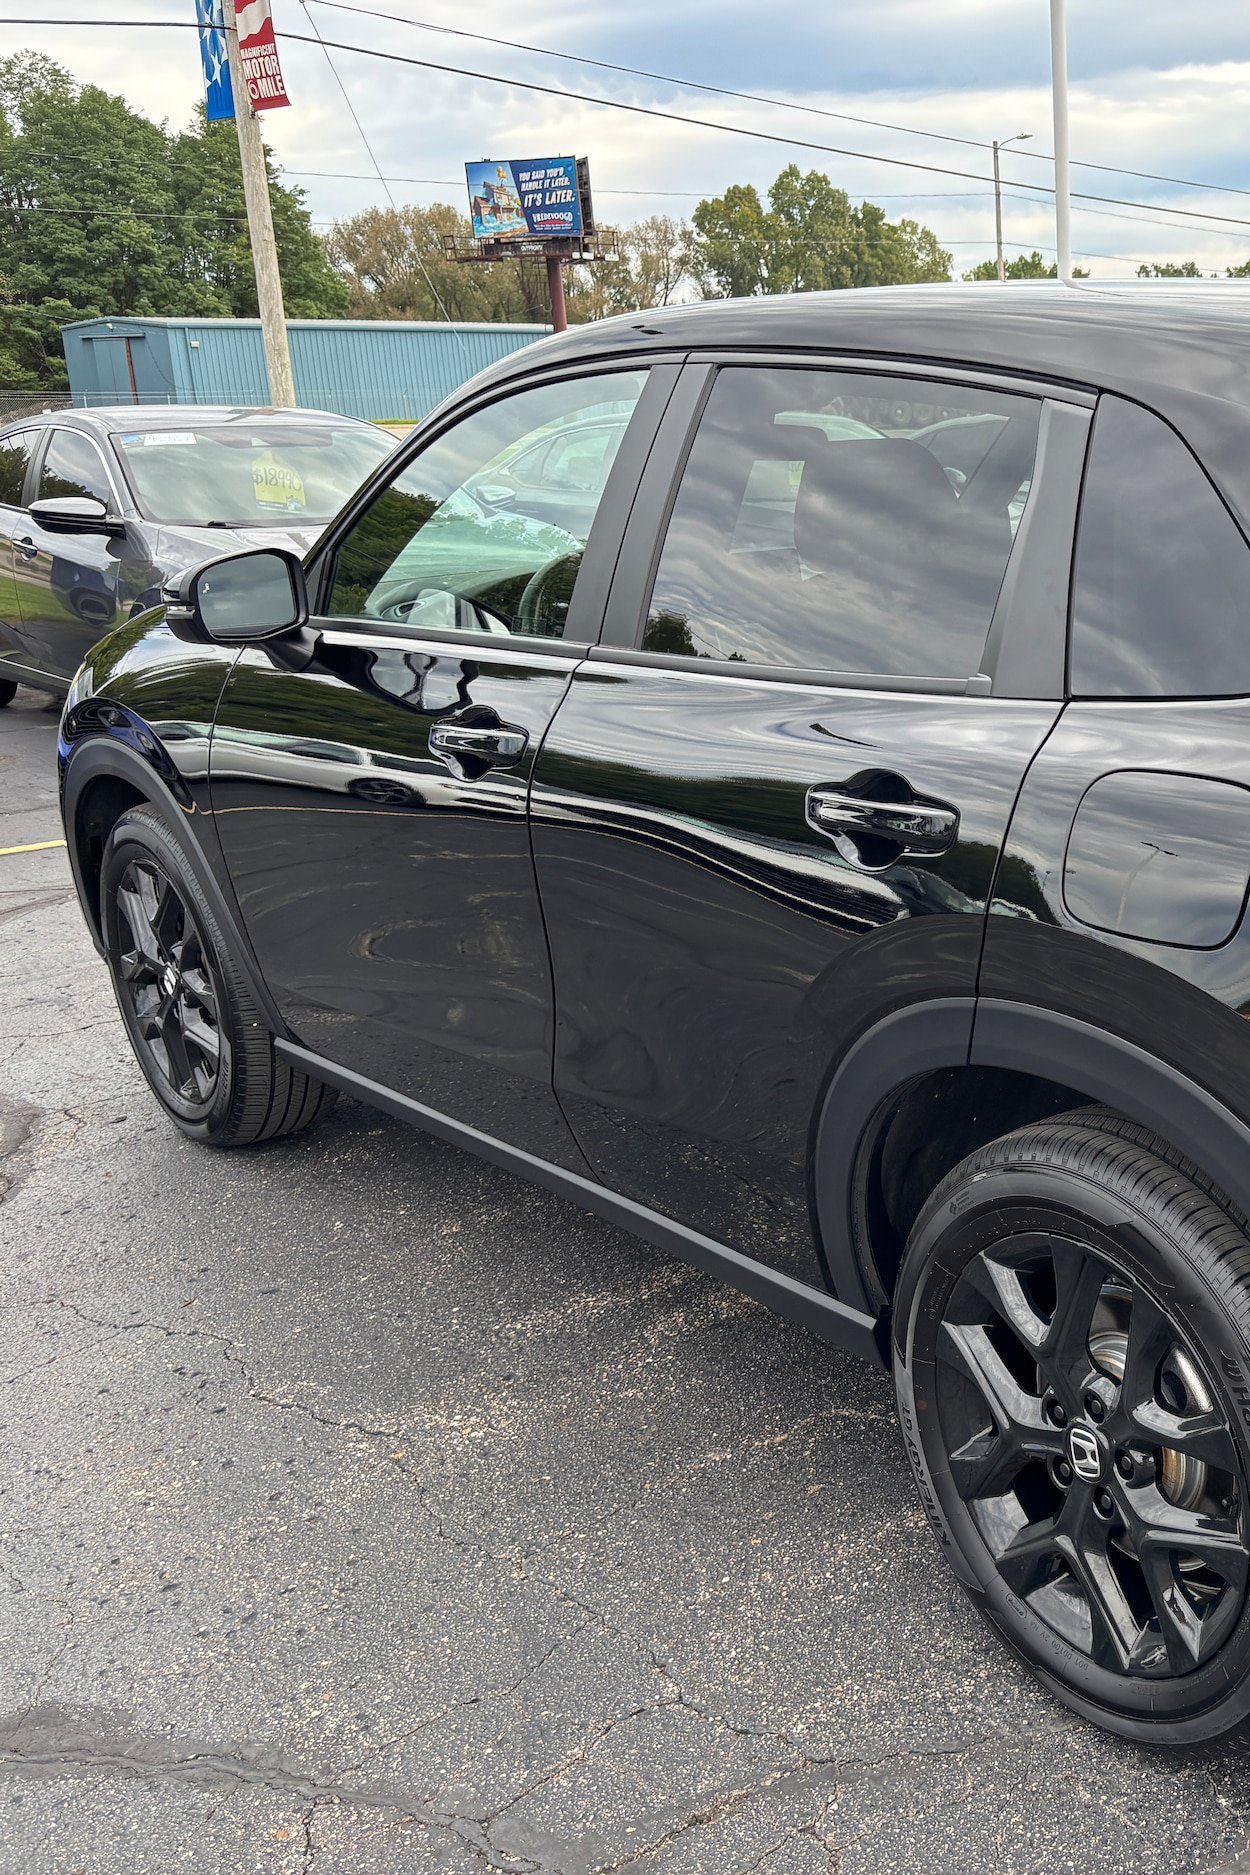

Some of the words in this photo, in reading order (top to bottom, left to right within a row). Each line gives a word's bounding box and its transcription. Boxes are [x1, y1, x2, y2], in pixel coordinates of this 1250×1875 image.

[240, 43, 276, 59] MAGNIFICENT
[242, 55, 280, 79] MOTOR
[257, 75, 285, 98] MILE
[518, 172, 531, 181] YOU
[531, 169, 545, 179] SAID
[520, 180, 543, 191] HANDLE
[543, 179, 550, 188] IT
[524, 193, 542, 208] IT'S
[545, 190, 575, 205] LATER.
[901, 1401, 913, 1432] GT
[905, 1433, 951, 1546] KINERGY
